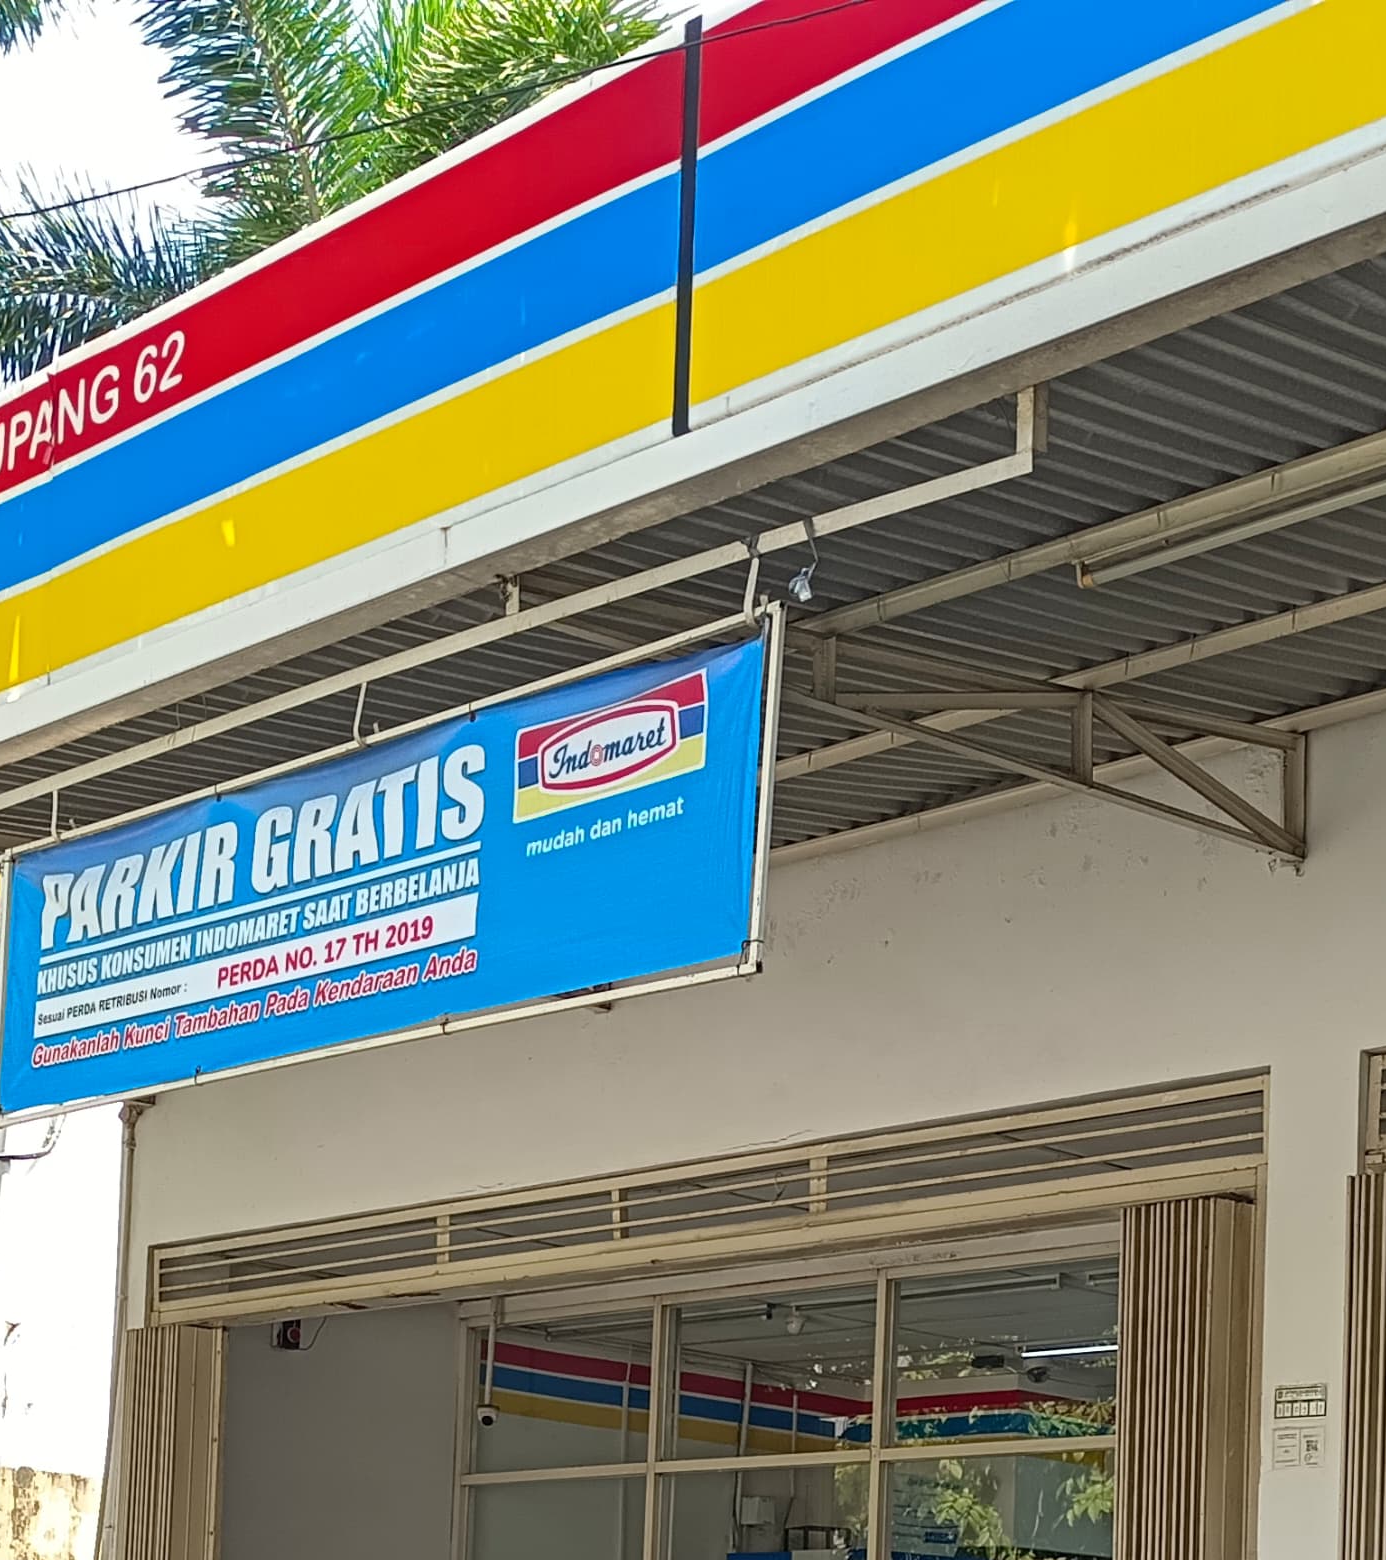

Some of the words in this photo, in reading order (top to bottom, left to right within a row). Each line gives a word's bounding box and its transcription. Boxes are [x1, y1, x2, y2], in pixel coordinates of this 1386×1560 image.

[133, 330, 185, 403] 62
[549, 717, 667, 779] Indomaret
[40, 820, 238, 950] PARKIR
[251, 744, 486, 894] GRATIS
[526, 827, 585, 857] mudah
[589, 815, 623, 840] dan
[627, 796, 685, 830] hemat
[37, 957, 98, 996] KHUSUS
[100, 932, 191, 975] KONSUMEN
[195, 906, 301, 957] INDOMARET
[302, 892, 353, 930] SAAT
[355, 858, 480, 917] BERBELANJA
[217, 957, 279, 989] PERDA
[285, 945, 318, 974] NO.
[324, 938, 347, 964] 17
[352, 929, 379, 956] TH
[385, 915, 434, 950] 2019
[32, 1031, 120, 1067] Gunakanlah
[123, 1014, 171, 1048] Kunci
[174, 999, 261, 1037] Tambahan
[264, 986, 309, 1017] Pada
[313, 964, 418, 1007] Kendaraan
[423, 946, 478, 982] Anda
[37, 1009, 65, 1026] Sesuai
[66, 1002, 97, 1020] PERDA
[99, 990, 148, 1012] RETRIBUSI
[149, 984, 181, 1001] Nomor
